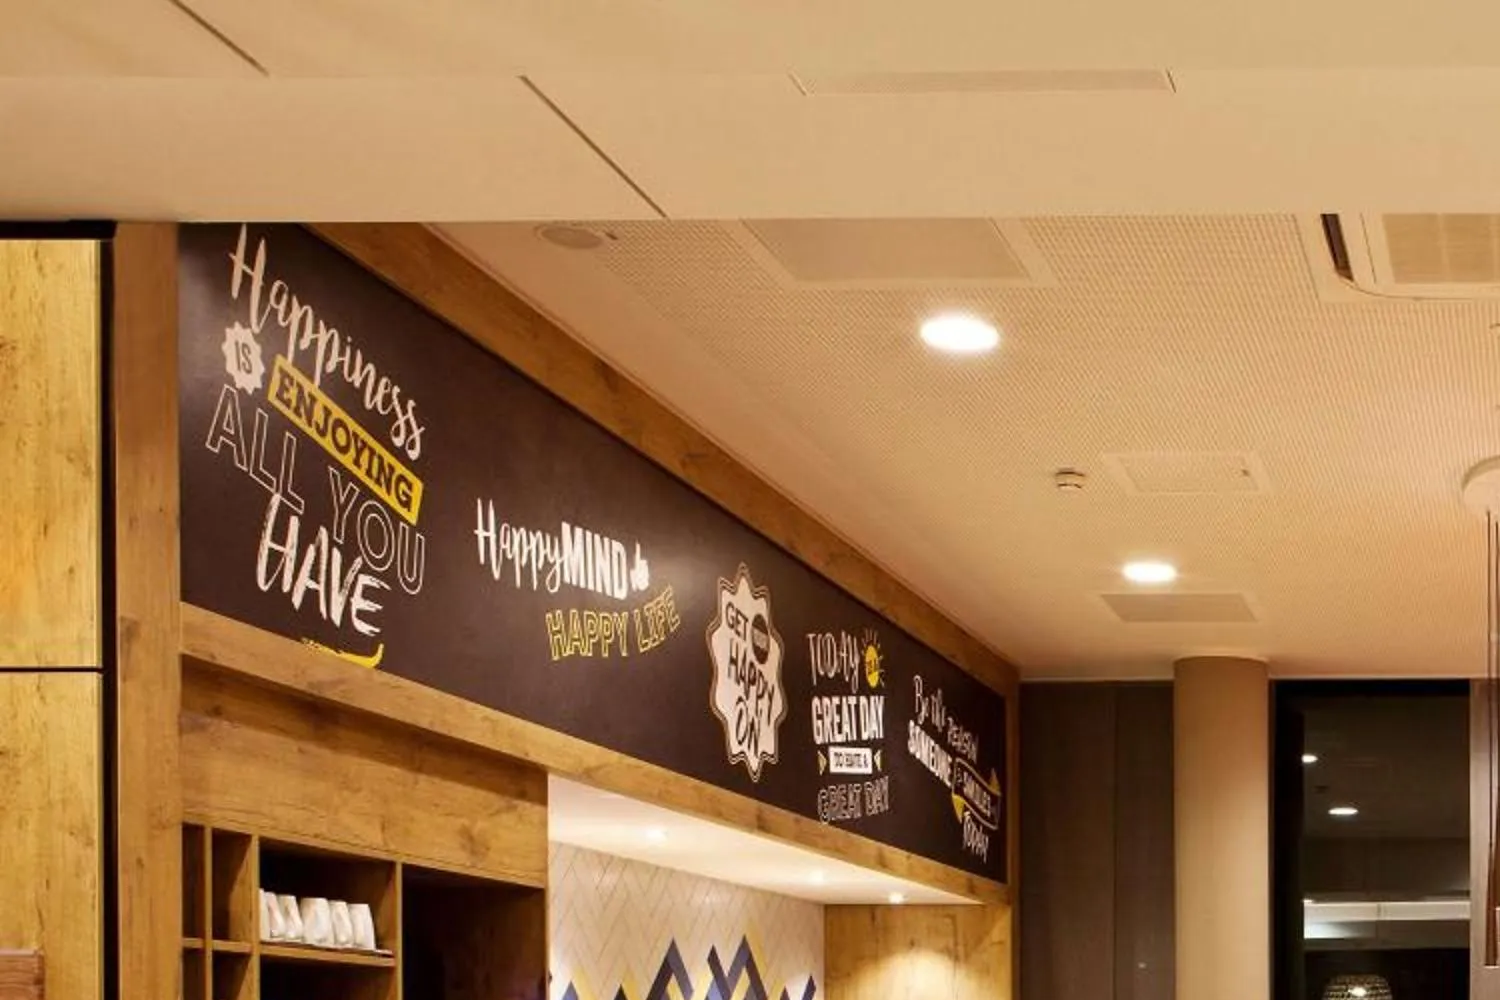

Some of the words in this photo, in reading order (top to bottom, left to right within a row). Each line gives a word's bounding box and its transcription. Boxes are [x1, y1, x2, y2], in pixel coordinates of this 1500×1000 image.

[229, 223, 425, 461] Happiness
[235, 340, 252, 374] IS
[274, 368, 415, 514] ENJOYING
[206, 384, 304, 514] ALL
[328, 465, 425, 595] YOU
[257, 494, 390, 637] HAVE
[562, 521, 628, 600] MIND
[545, 608, 628, 661] HAPPY
[635, 586, 681, 655] LIFE
[726, 601, 749, 642] GET
[727, 638, 775, 726] HAPPY
[811, 696, 857, 745] GREAT
[859, 695, 884, 741] DAY
[735, 696, 760, 759] ON
